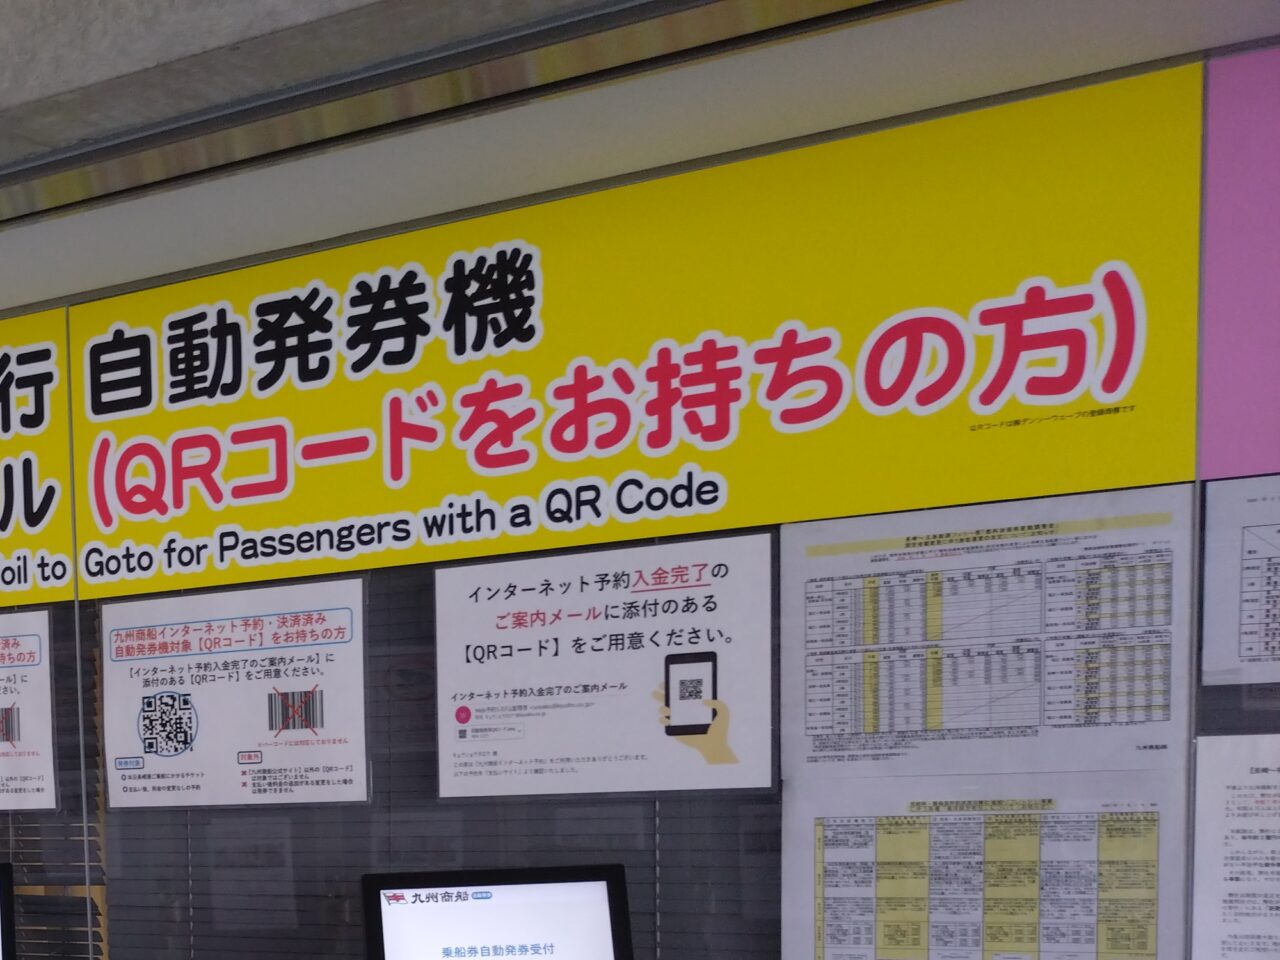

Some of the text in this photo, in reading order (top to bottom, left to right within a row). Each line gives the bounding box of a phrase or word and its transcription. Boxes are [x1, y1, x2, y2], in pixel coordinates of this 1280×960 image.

[90, 247, 538, 416] 自動発券機
[93, 270, 1137, 527] (QRコードをお持ちの方)
[37, 557, 68, 583] to
[85, 541, 154, 576] Goto
[163, 538, 209, 569] for
[219, 516, 412, 561] Passengers
[423, 500, 498, 539] with
[509, 505, 533, 528] a
[545, 484, 603, 524] QR
[615, 471, 720, 514] Code
[468, 563, 729, 603] インターネット予約入金完了の
[495, 594, 718, 630] ご案内メールに添付のある
[464, 627, 732, 664] 【QRコード】をご用意ください。
[441, 943, 555, 959] 乗船券自動発券受付
